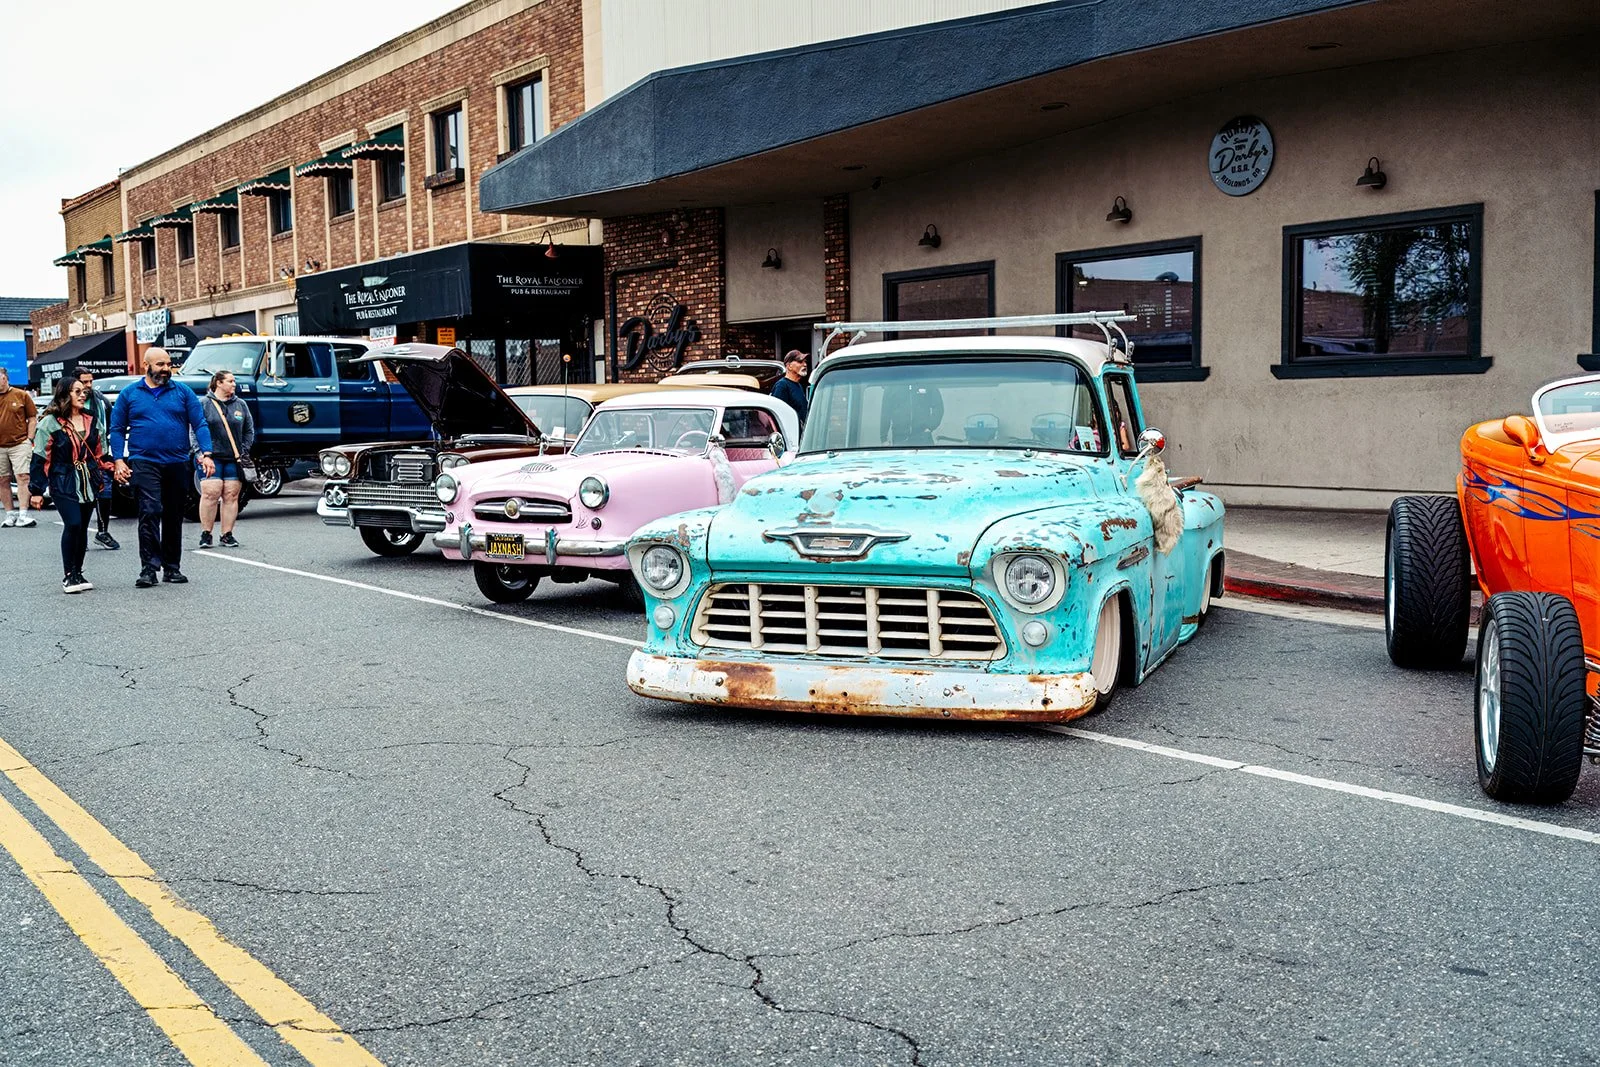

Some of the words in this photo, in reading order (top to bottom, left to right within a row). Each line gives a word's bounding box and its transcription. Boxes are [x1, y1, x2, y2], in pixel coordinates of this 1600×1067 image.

[1212, 139, 1269, 173] Darby's
[496, 274, 513, 284] THE
[515, 275, 542, 286] ROYAL
[543, 276, 584, 286] FALCONER
[344, 293, 357, 305] THE
[357, 291, 375, 305] ROYAL
[374, 285, 406, 302] FALCONER
[368, 306, 398, 319] RESTAURANT
[488, 542, 522, 555] JAXNASH
